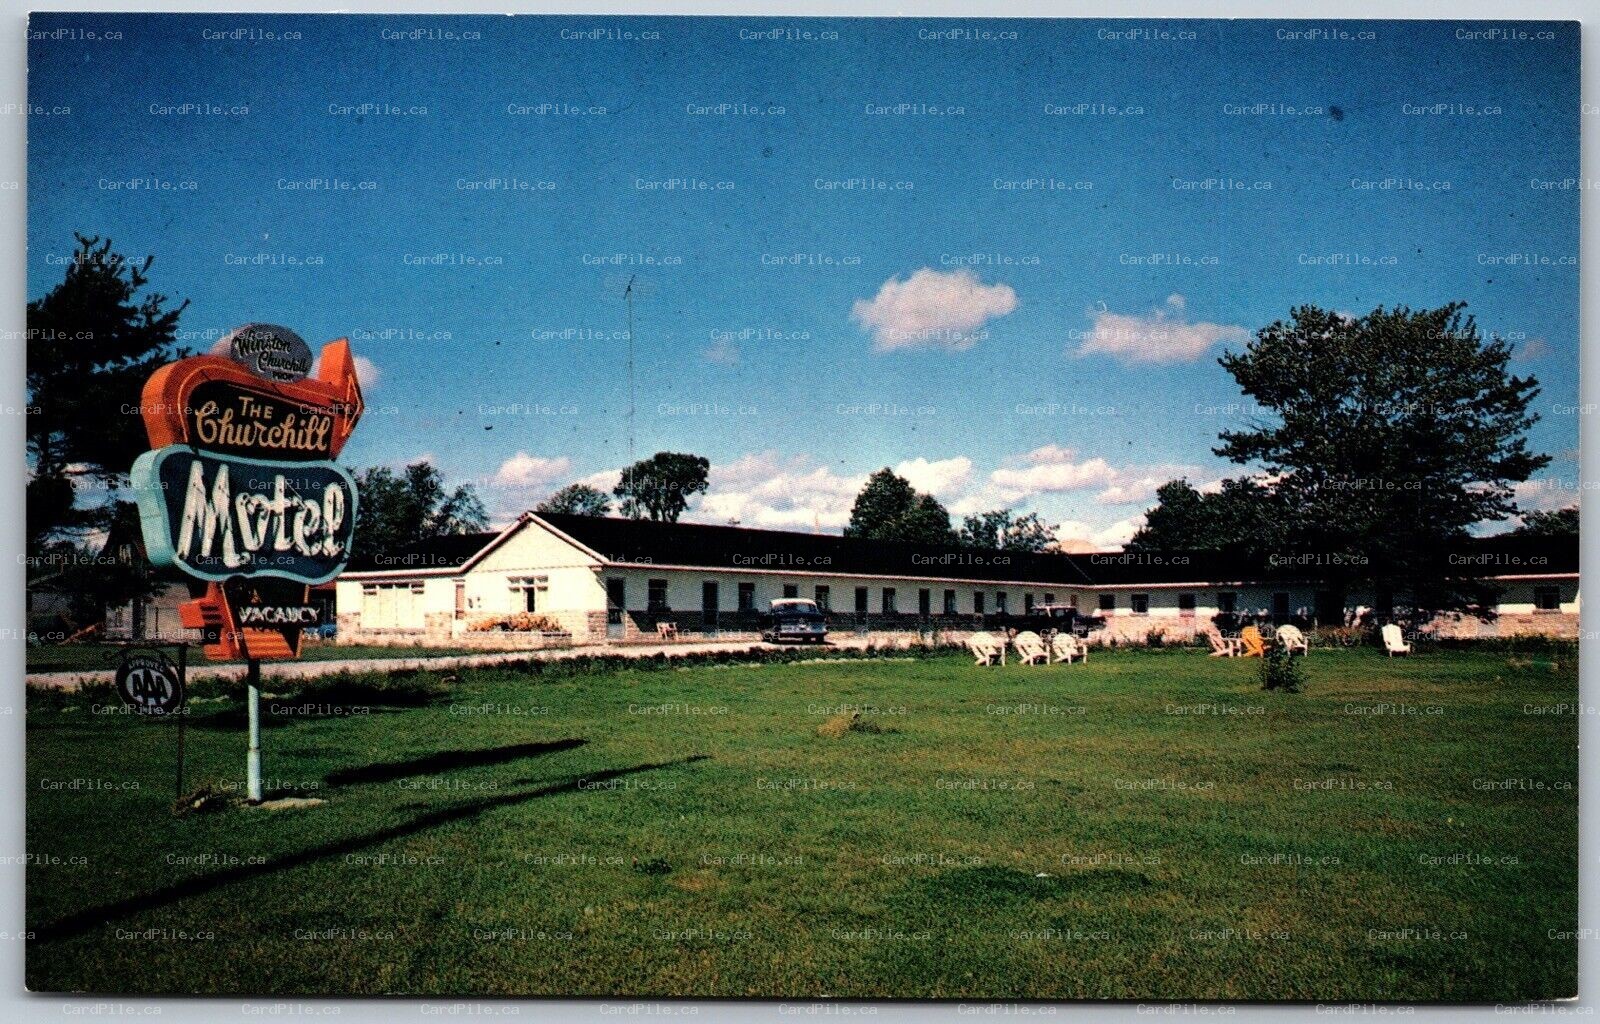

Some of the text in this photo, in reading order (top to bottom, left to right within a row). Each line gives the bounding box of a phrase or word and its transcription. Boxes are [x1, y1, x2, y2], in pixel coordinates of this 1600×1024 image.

[257, 350, 309, 374] Churchill
[238, 396, 274, 420] THE
[195, 401, 331, 451] Churchill
[177, 460, 346, 568] Motel
[239, 606, 320, 623] VACANCY
[132, 668, 169, 706] AAA
